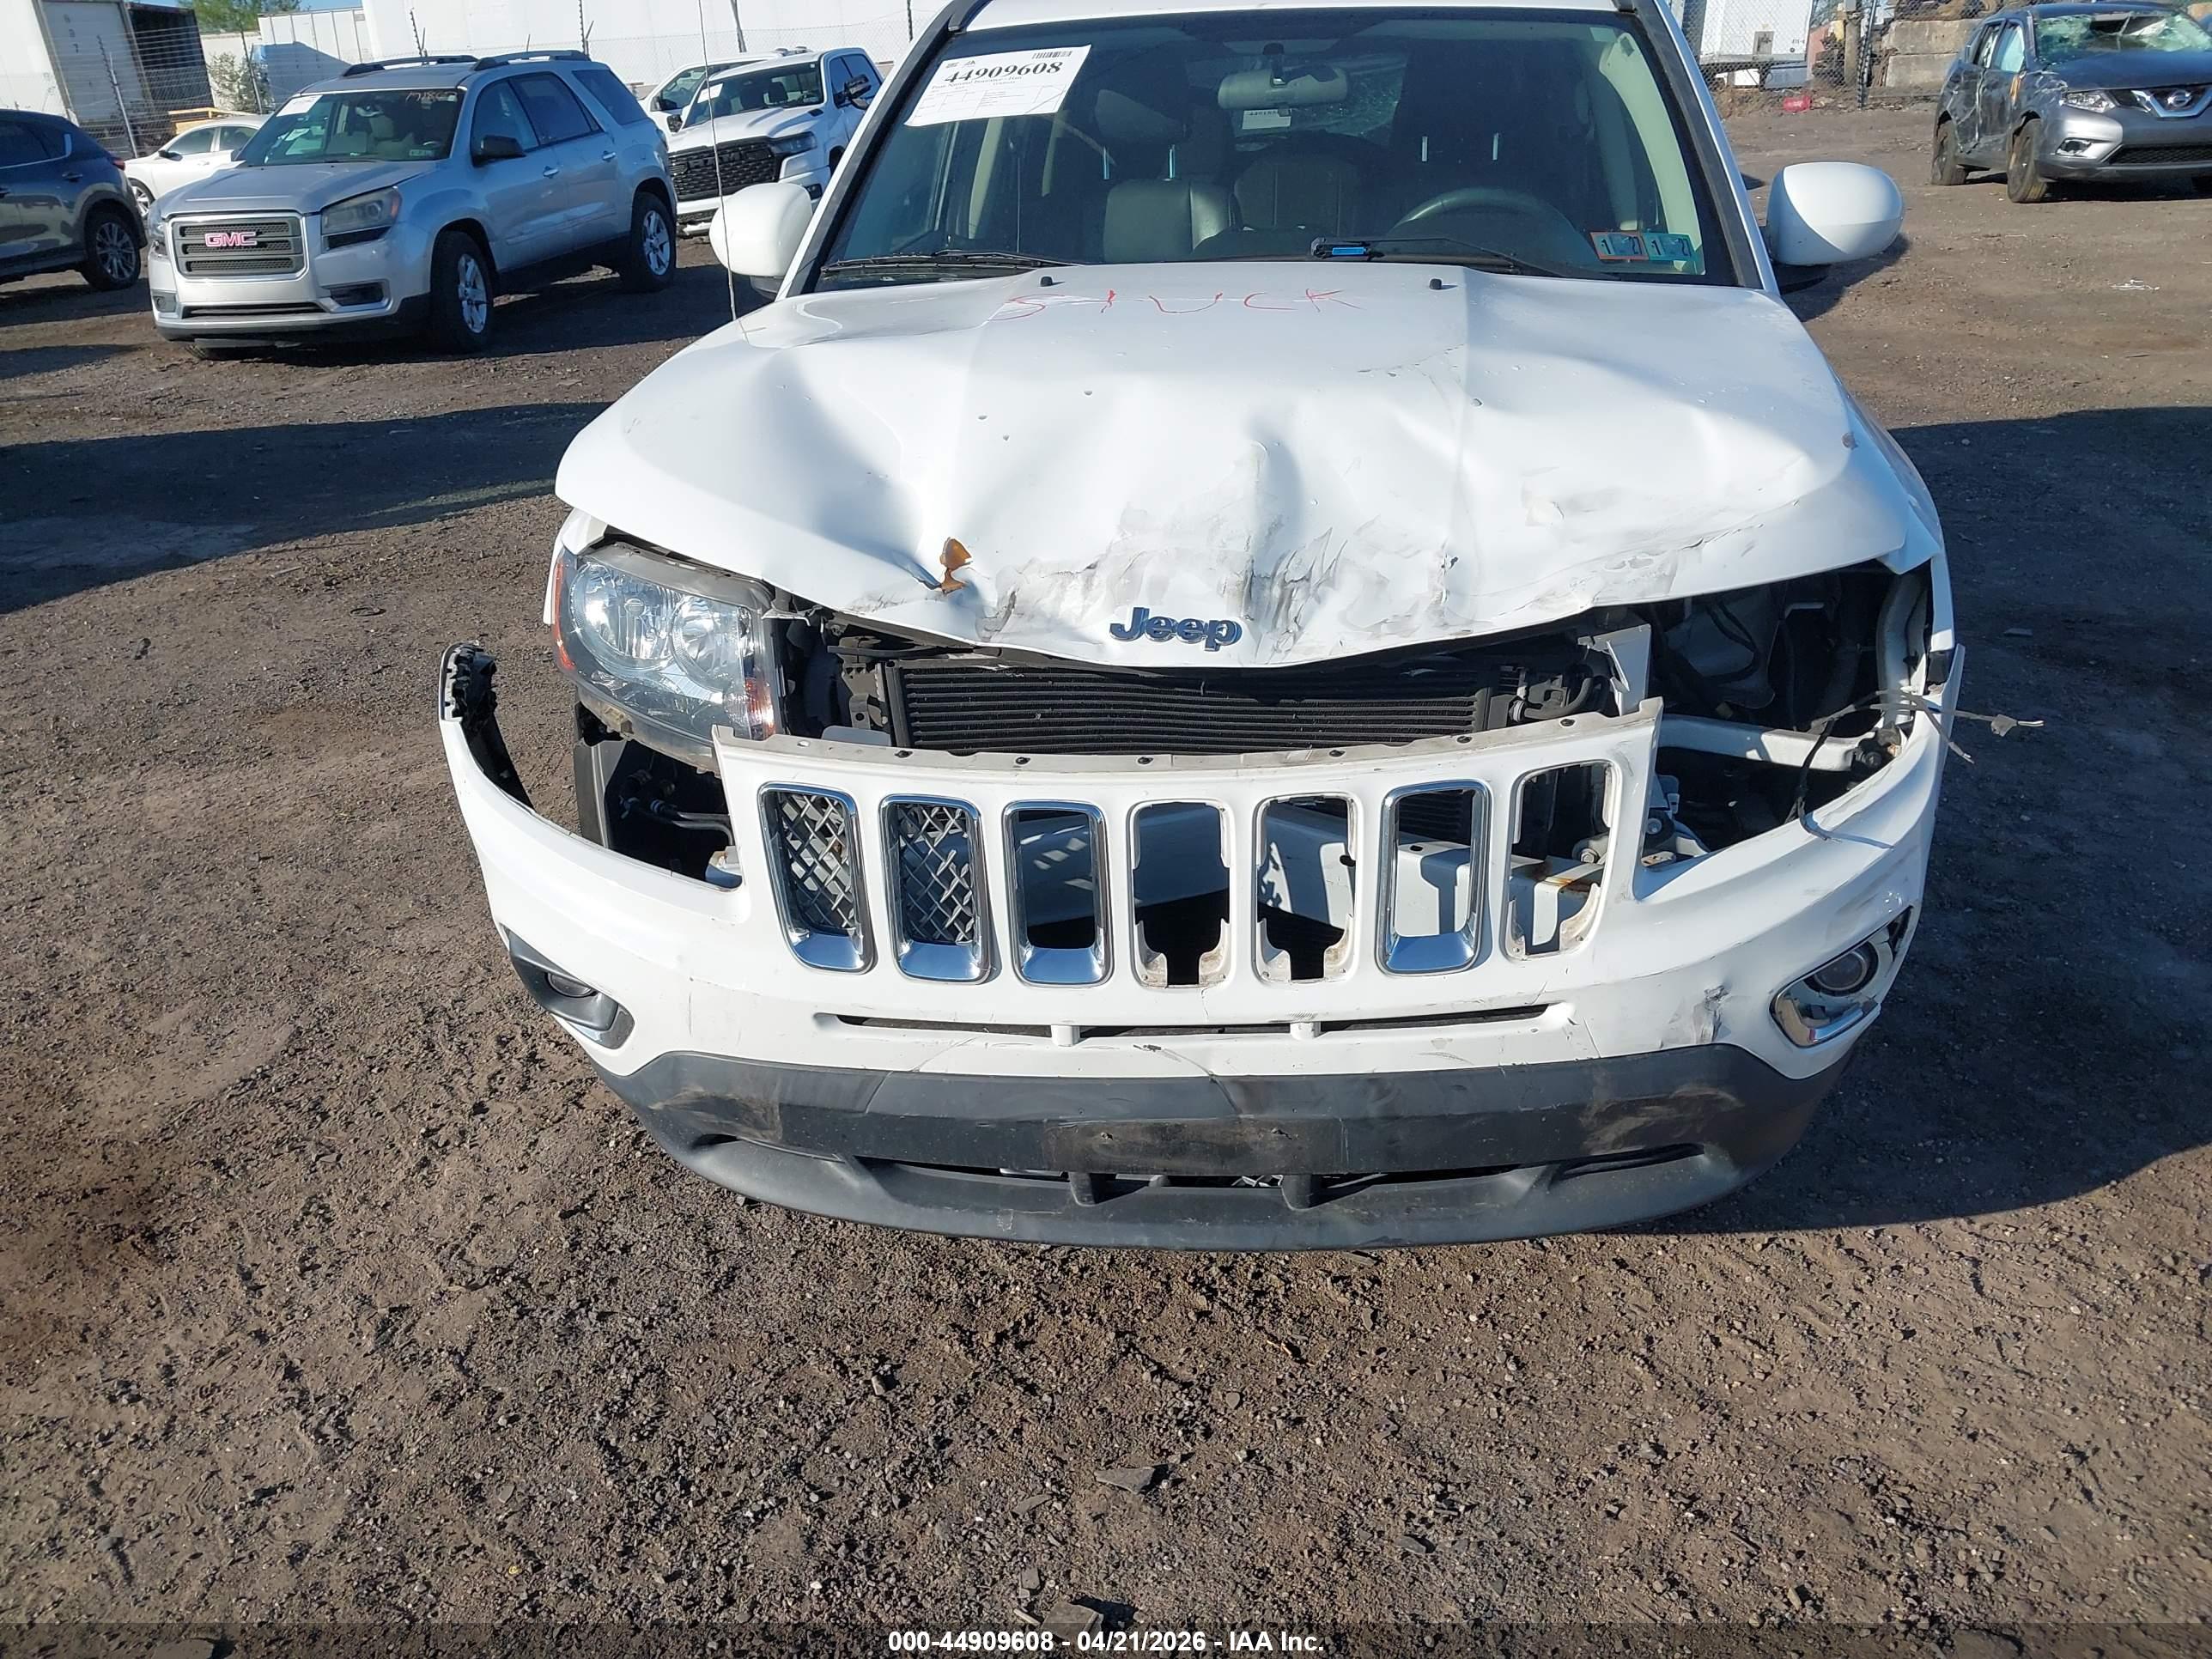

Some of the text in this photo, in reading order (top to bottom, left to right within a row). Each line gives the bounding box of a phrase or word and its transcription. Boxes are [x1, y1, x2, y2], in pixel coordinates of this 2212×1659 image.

[945, 61, 1063, 83] 44909608
[204, 231, 258, 247] GMC
[1601, 239, 1611, 254] 1
[1651, 240, 1662, 256] 1
[1109, 607, 1243, 652] Jeep
